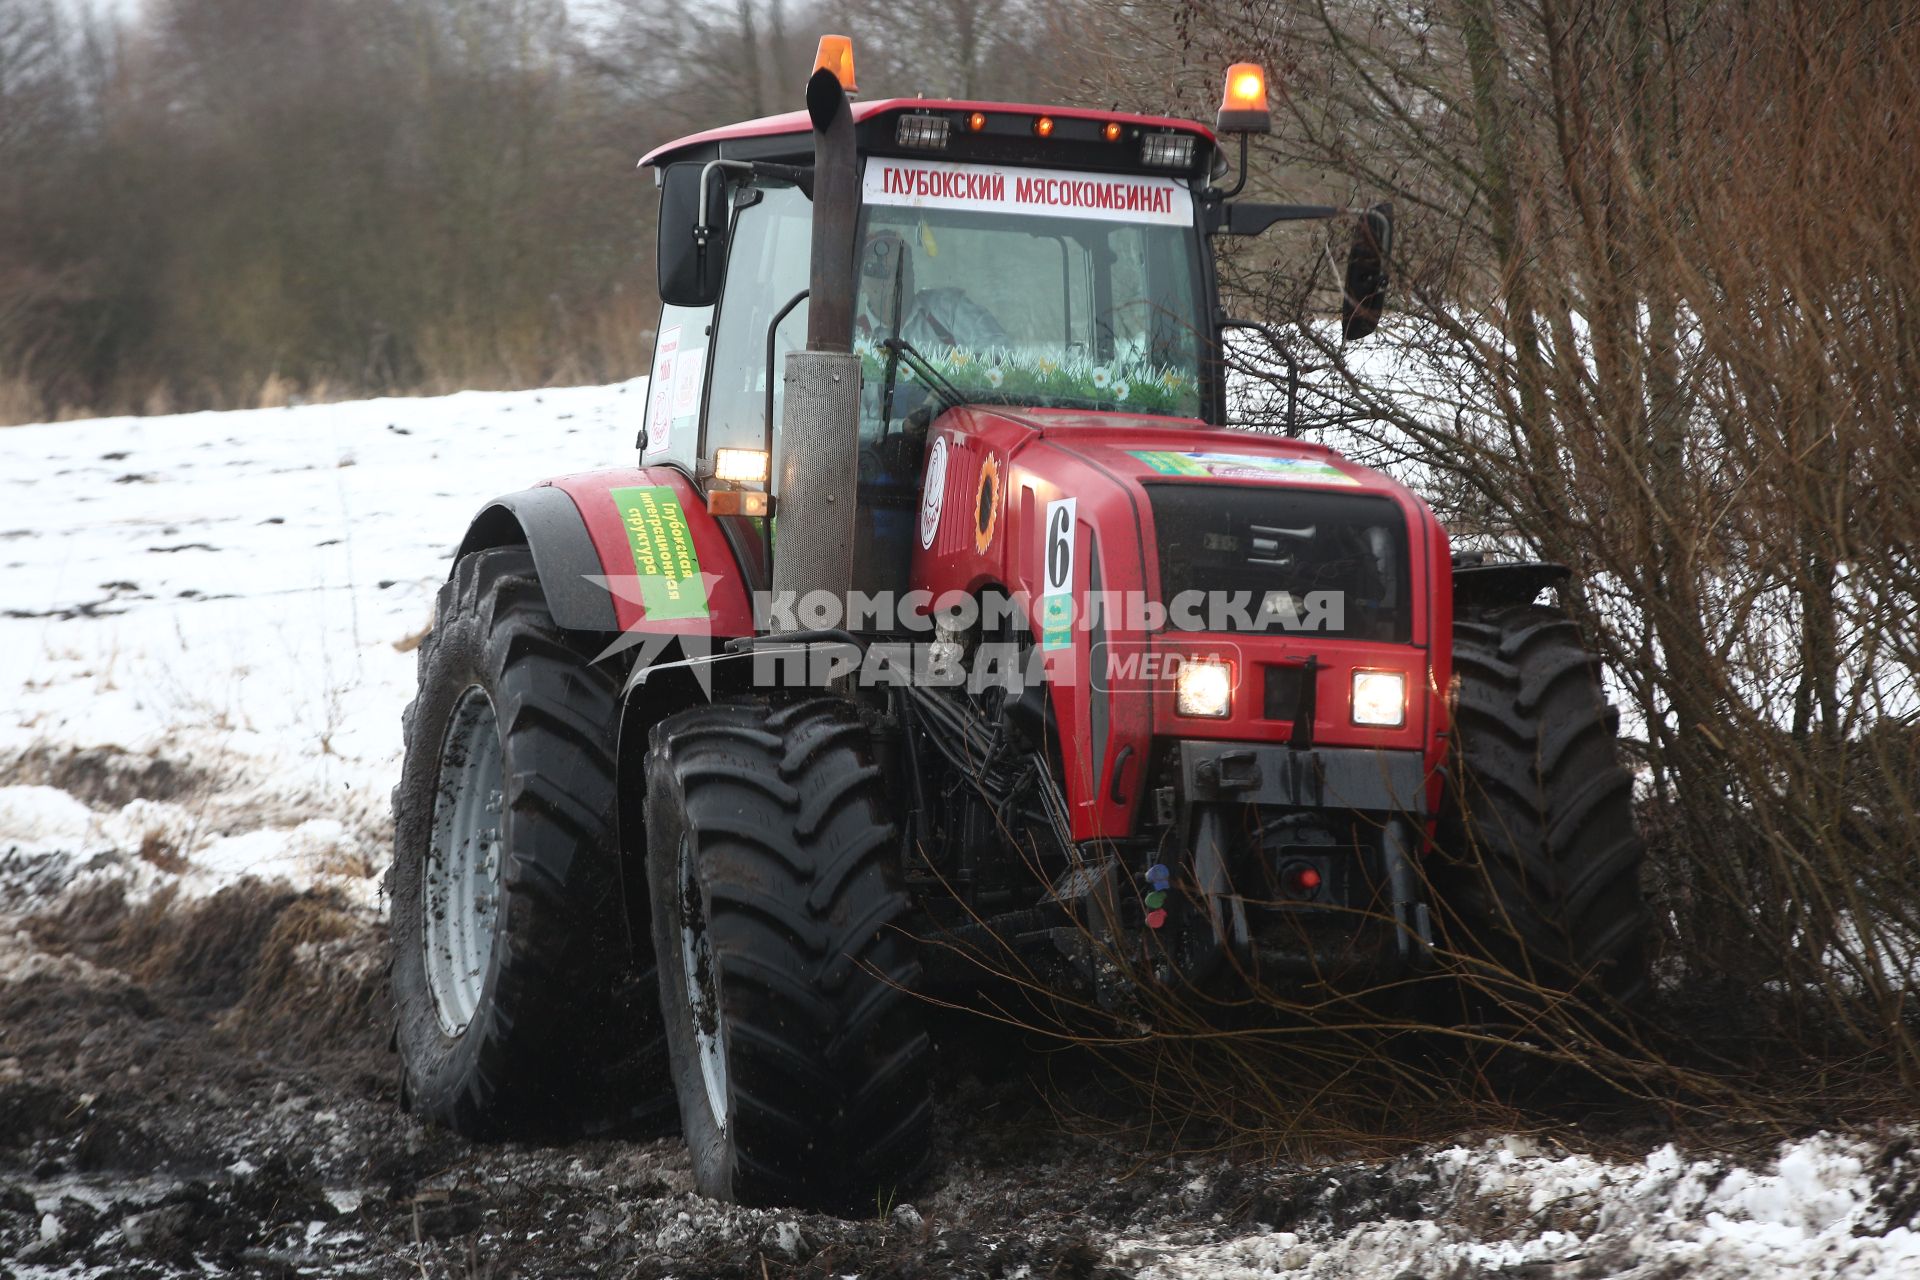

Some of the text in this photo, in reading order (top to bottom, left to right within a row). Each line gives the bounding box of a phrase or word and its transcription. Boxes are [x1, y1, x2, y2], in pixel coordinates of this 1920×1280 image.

[883, 167, 1174, 213] ГЛУБОКСКИЙ МЯСОКОМБИНАТ
[626, 508, 657, 575] структура
[639, 492, 680, 600] интеграционная
[661, 502, 693, 578] Глубокская
[1048, 506, 1070, 588] 6
